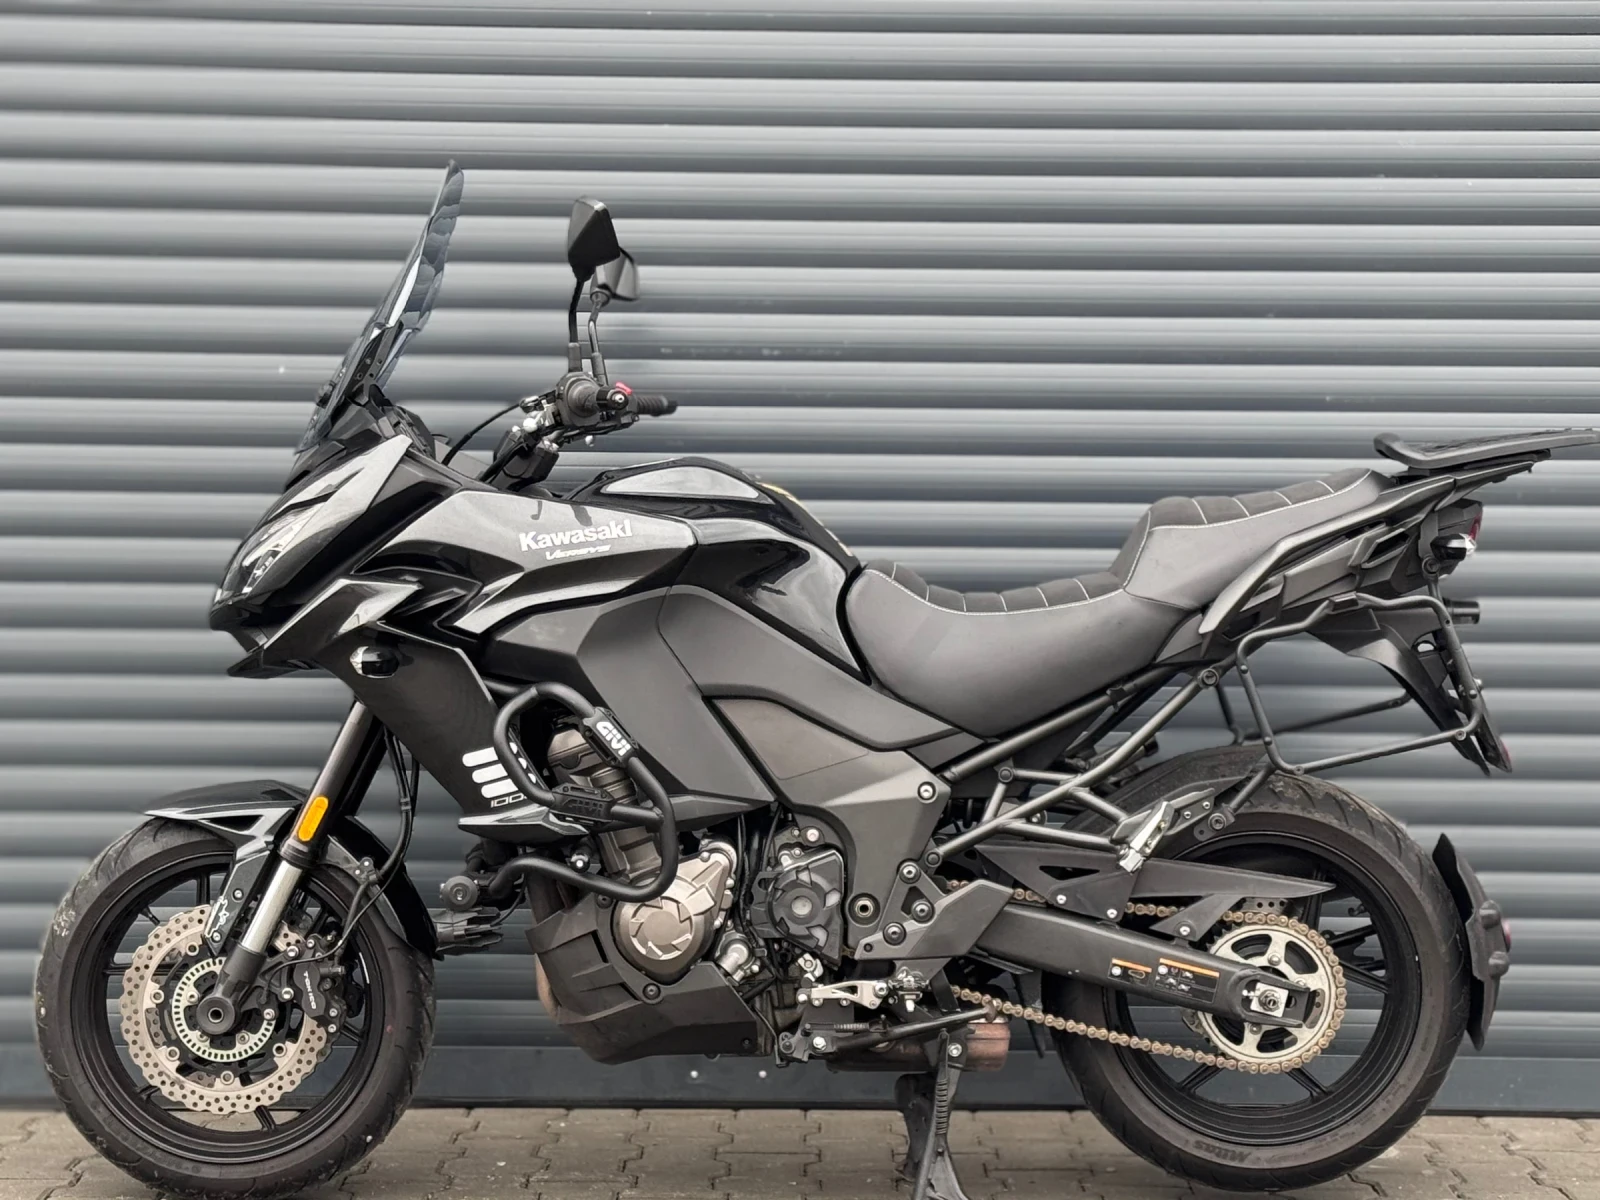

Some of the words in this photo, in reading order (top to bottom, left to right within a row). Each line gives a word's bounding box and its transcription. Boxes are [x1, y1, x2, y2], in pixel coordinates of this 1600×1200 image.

[519, 519, 633, 552] Kawasaki
[596, 721, 632, 757] GIVI
[490, 792, 528, 808] 100
[302, 969, 317, 1010] TOKICO
